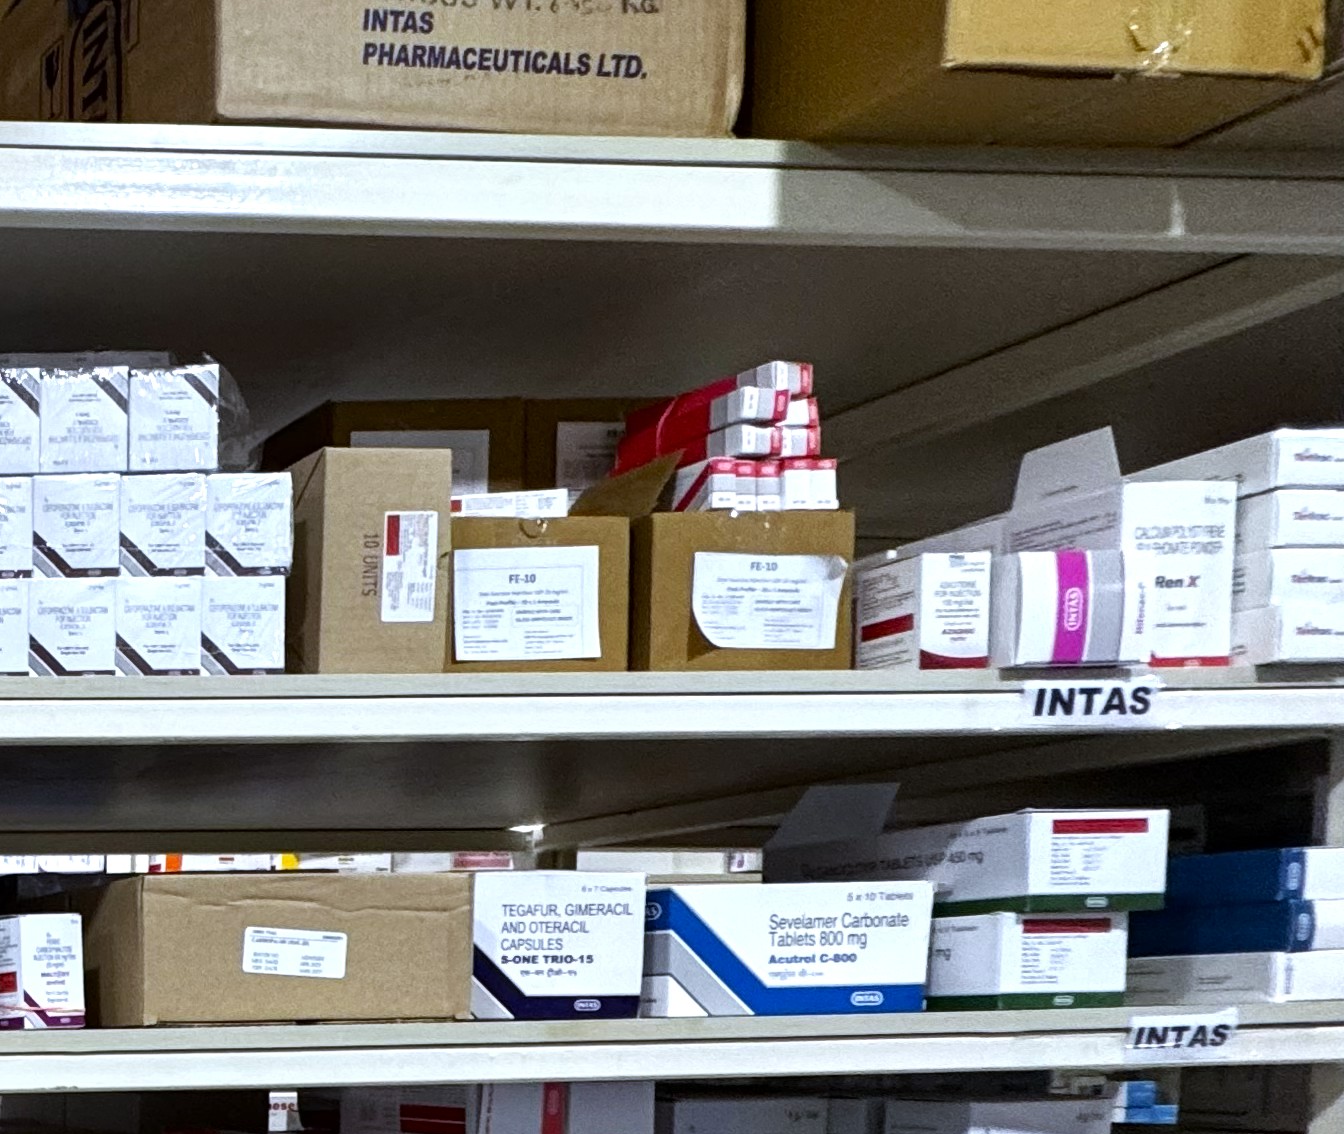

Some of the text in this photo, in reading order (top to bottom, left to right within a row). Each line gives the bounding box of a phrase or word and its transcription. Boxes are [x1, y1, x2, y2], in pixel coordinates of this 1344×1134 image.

[362, 9, 434, 34] INTAS
[362, 42, 648, 79] PHARMACEUTICALS LTD.
[361, 533, 378, 597] 10 UNITS
[750, 562, 777, 572] FE-10
[508, 573, 536, 585] FE-10
[1154, 575, 1200, 589] Ren X
[1033, 688, 1152, 717] INTAS
[502, 904, 633, 917] TEGAFUR, GIMERACIL
[501, 922, 590, 934] AND OTERACIL
[768, 913, 910, 930] Sevelamer Carbonate
[501, 939, 563, 950] CAPSULES
[768, 931, 867, 949] Tablets 800 mg
[501, 955, 594, 964] S-ONE TRIO-15
[768, 953, 857, 964] Acutrol C-800
[1133, 1025, 1229, 1049] INTAS
